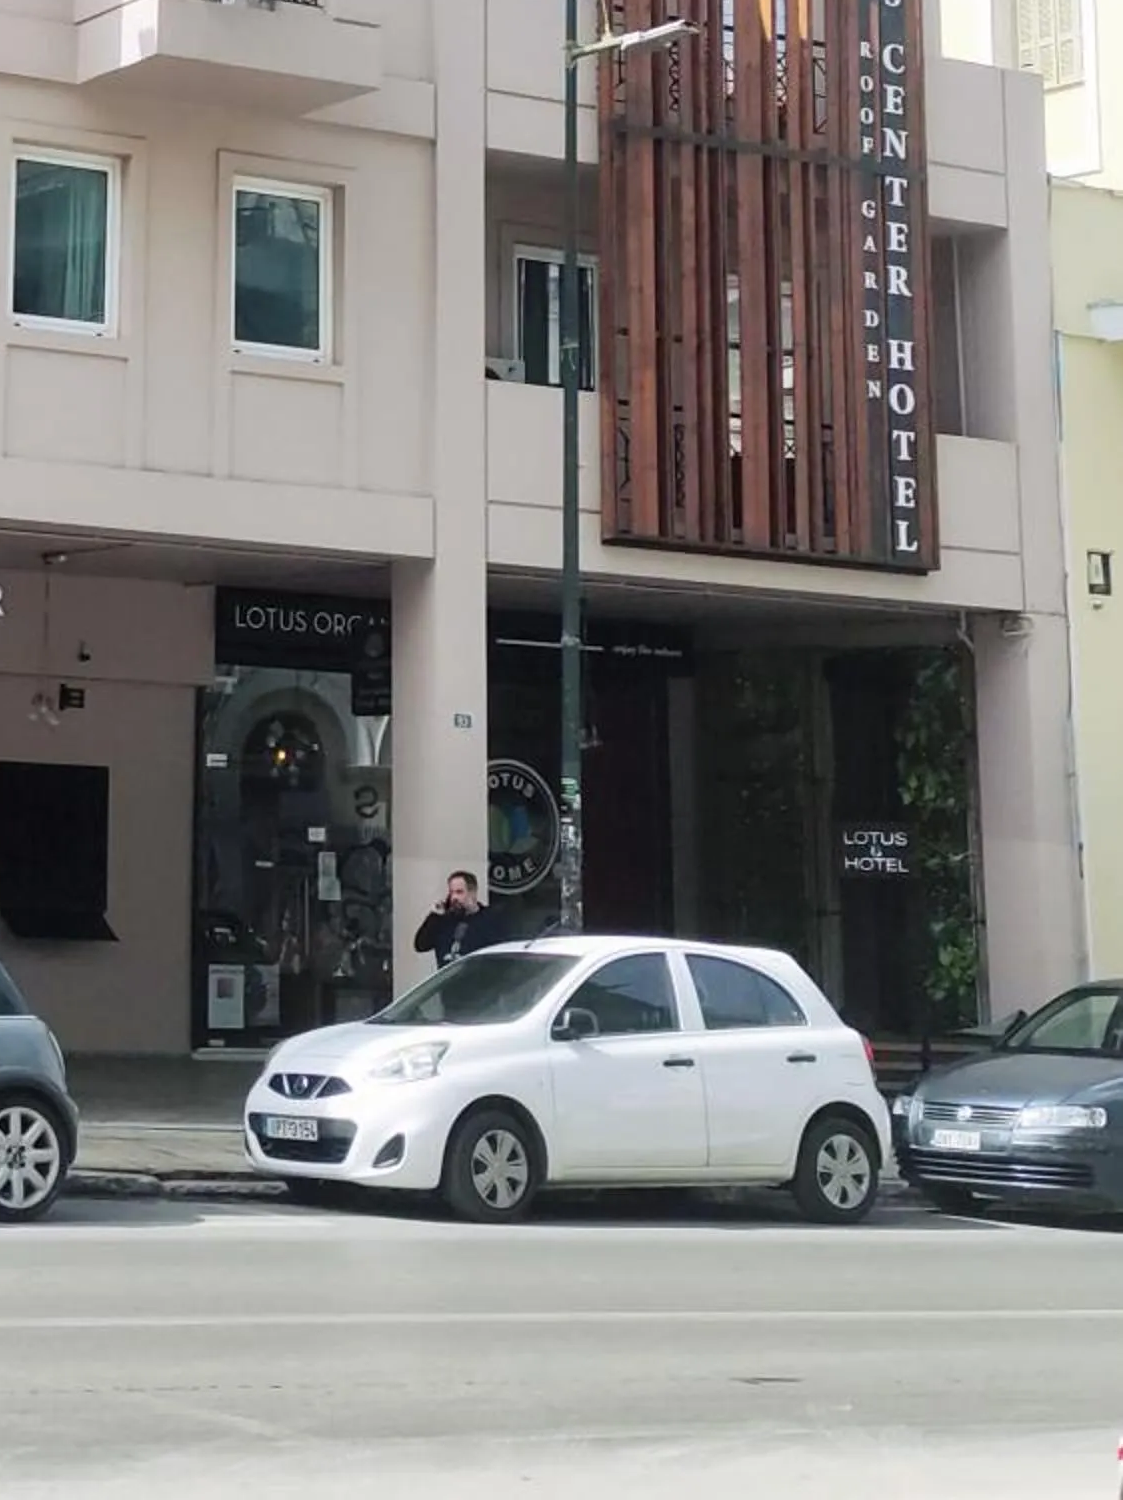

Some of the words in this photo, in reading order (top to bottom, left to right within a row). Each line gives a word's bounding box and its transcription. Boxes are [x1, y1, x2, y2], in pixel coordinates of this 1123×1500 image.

[860, 41, 875, 154] ROOF
[882, 43, 913, 298] CENTER
[861, 199, 881, 399] GARDEN
[888, 339, 918, 552] HOTEL
[235, 605, 307, 633] LOTUS
[488, 772, 536, 799] OTUS
[843, 831, 908, 846] LOTUS
[490, 856, 538, 883] OME
[844, 856, 909, 873] HOTEL
